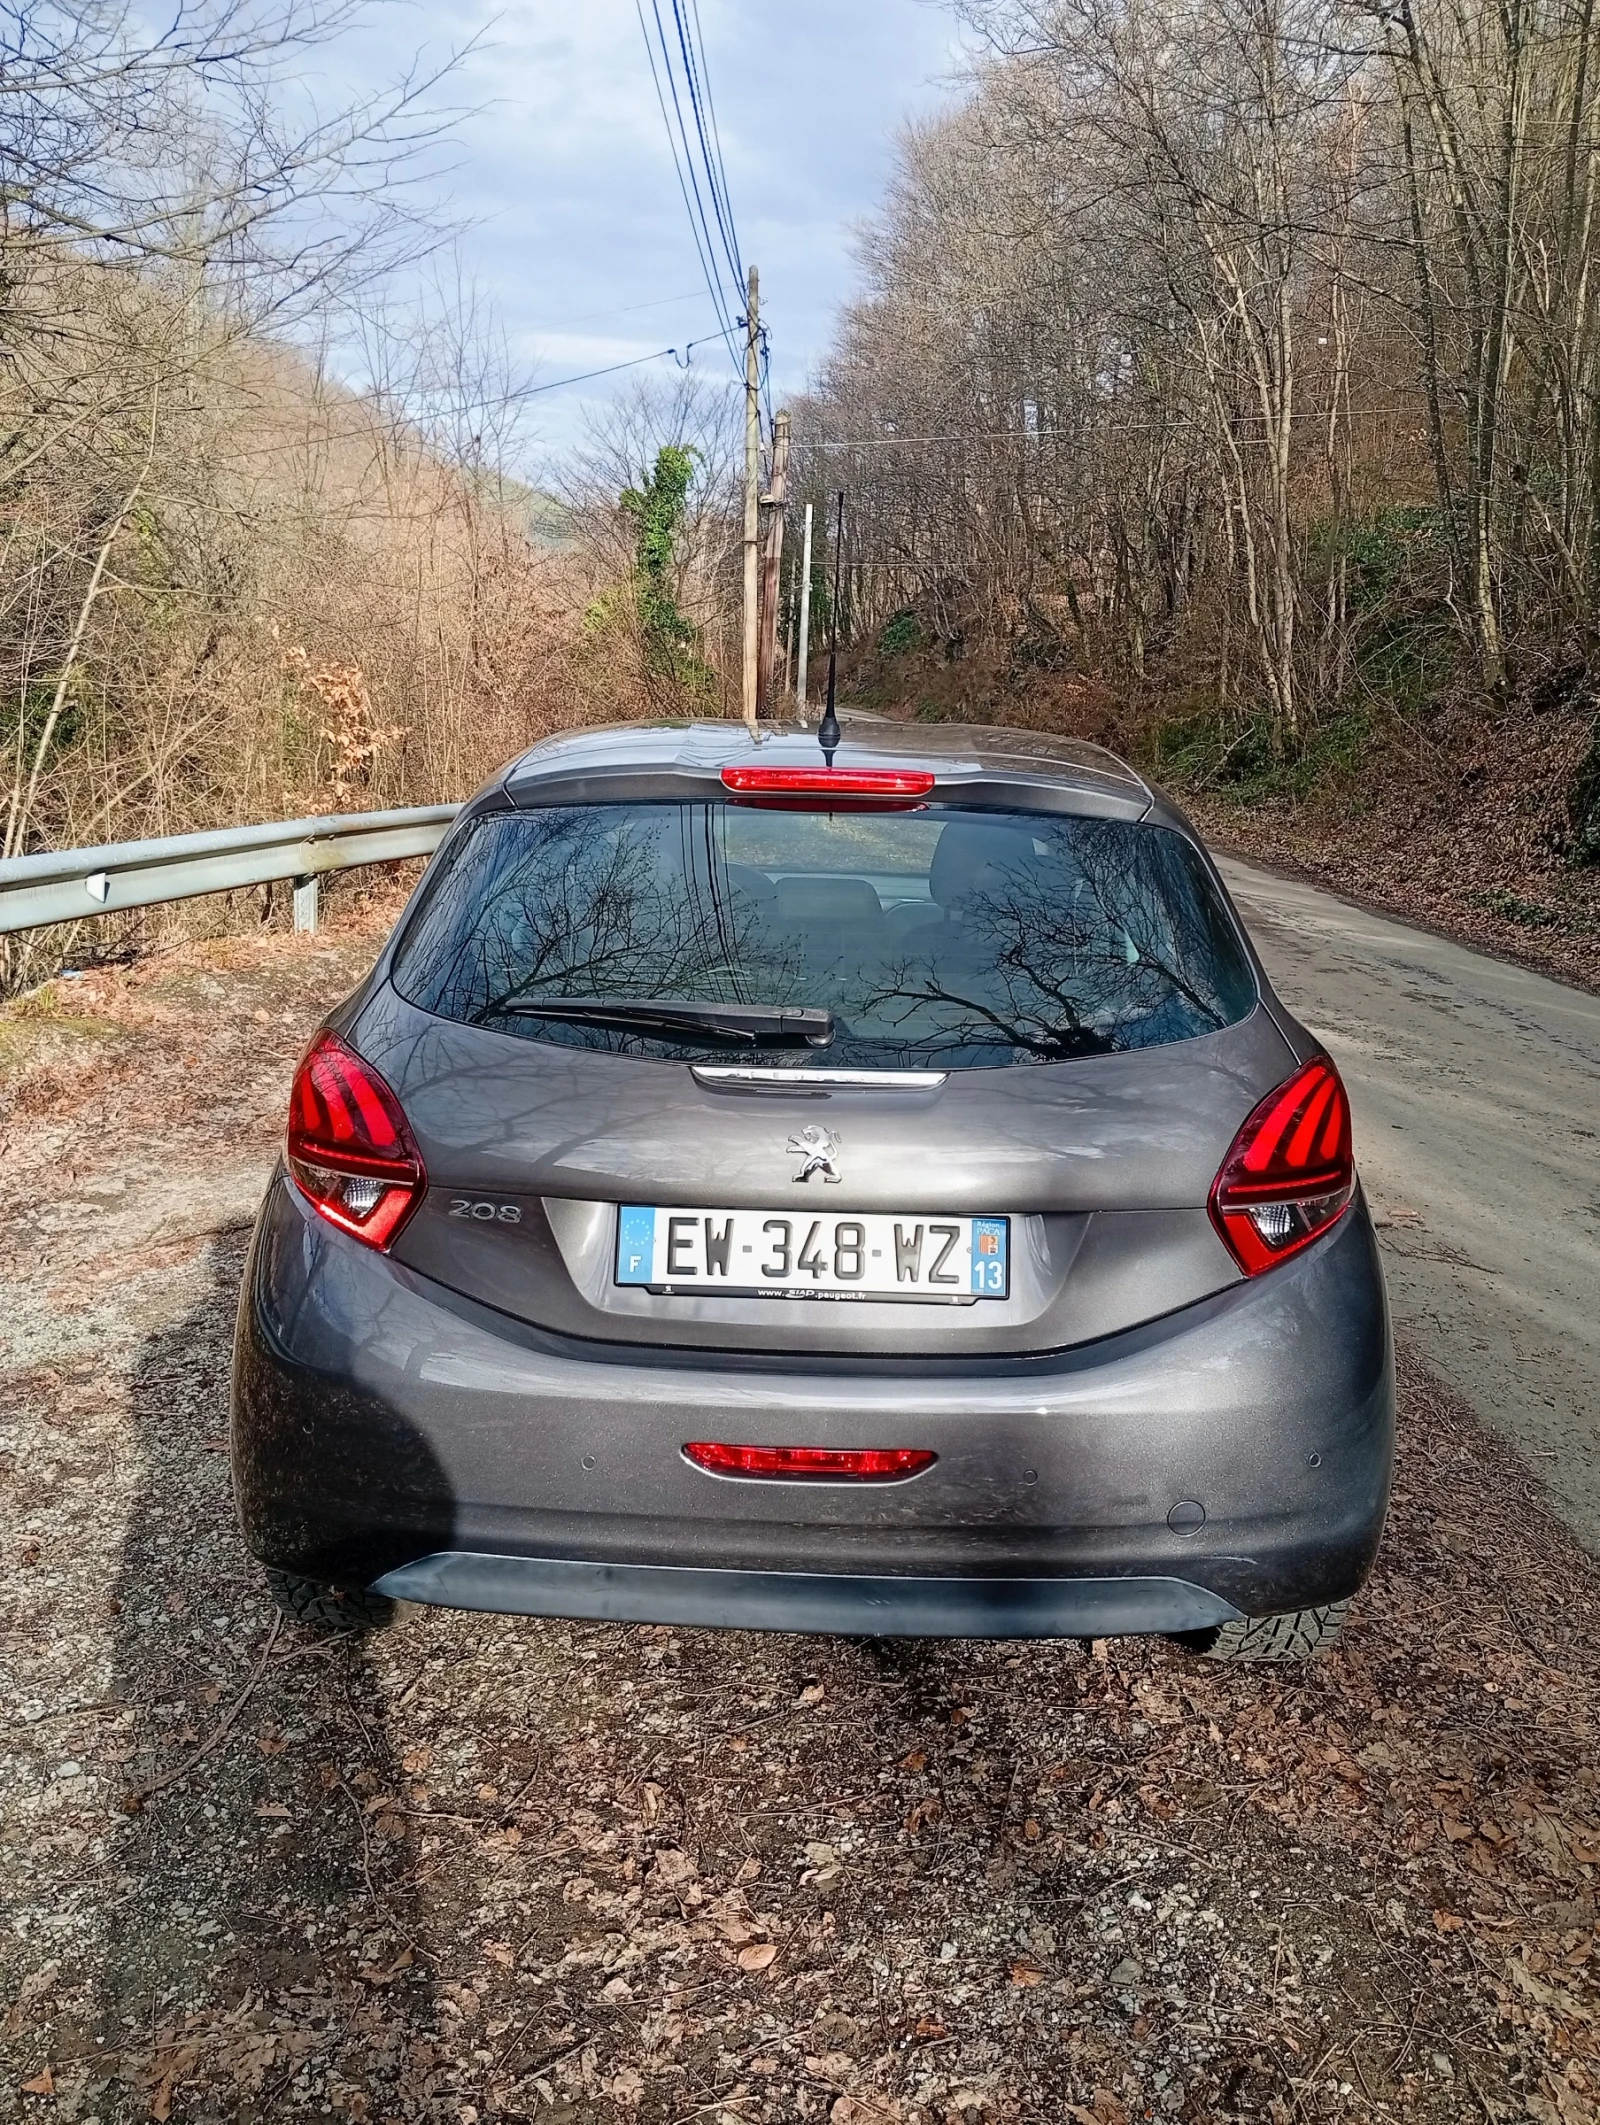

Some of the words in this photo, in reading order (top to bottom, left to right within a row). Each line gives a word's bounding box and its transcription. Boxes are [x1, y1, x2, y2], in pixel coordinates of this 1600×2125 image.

[448, 1200, 522, 1223] 208
[977, 1228, 1001, 1236] PACA
[629, 1255, 642, 1273] F
[974, 1260, 1003, 1290] 13
